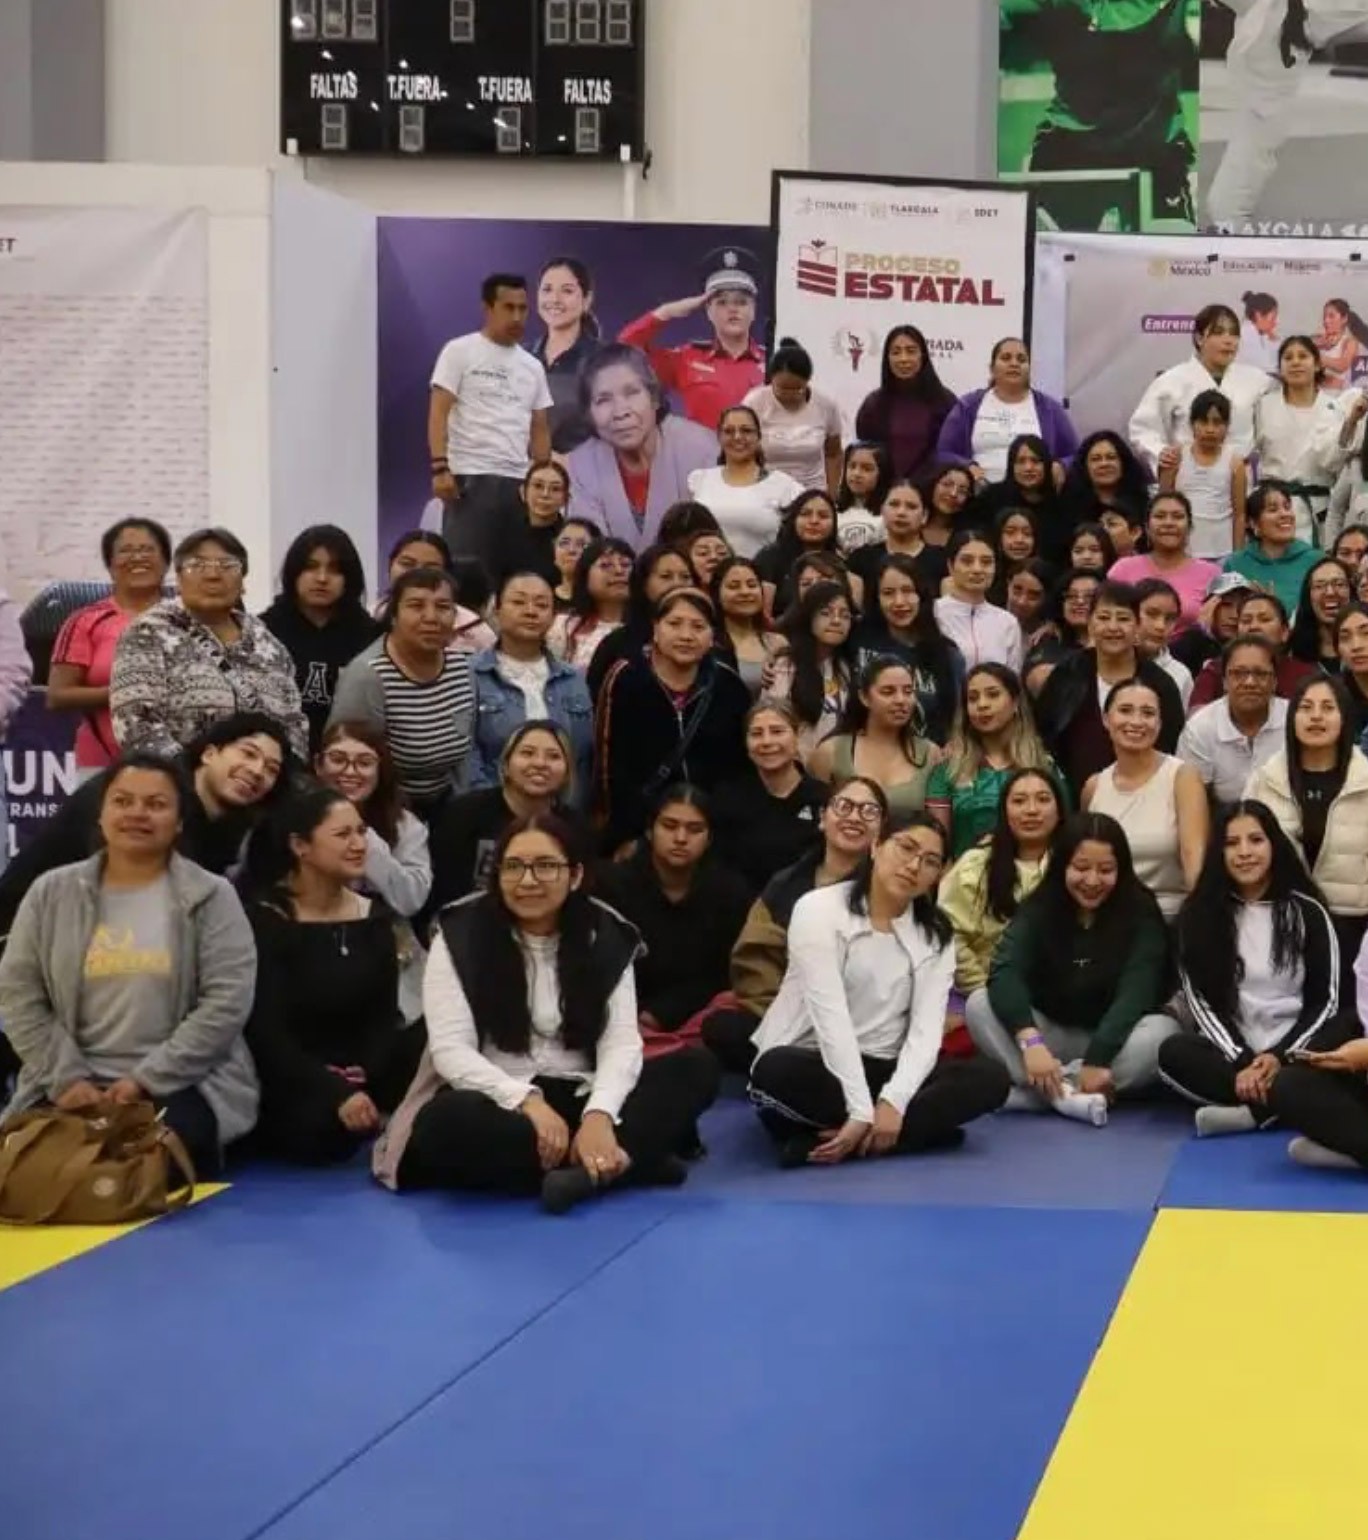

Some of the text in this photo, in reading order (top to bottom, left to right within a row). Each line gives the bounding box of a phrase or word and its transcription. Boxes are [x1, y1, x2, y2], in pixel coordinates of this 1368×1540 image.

[310, 73, 358, 98] FALTAS
[387, 76, 440, 101] T.FUERA
[479, 77, 532, 102] T.FUERA
[564, 79, 611, 104] FALTAS
[845, 253, 961, 274] PROCESO
[844, 271, 1005, 306] ESTATAL
